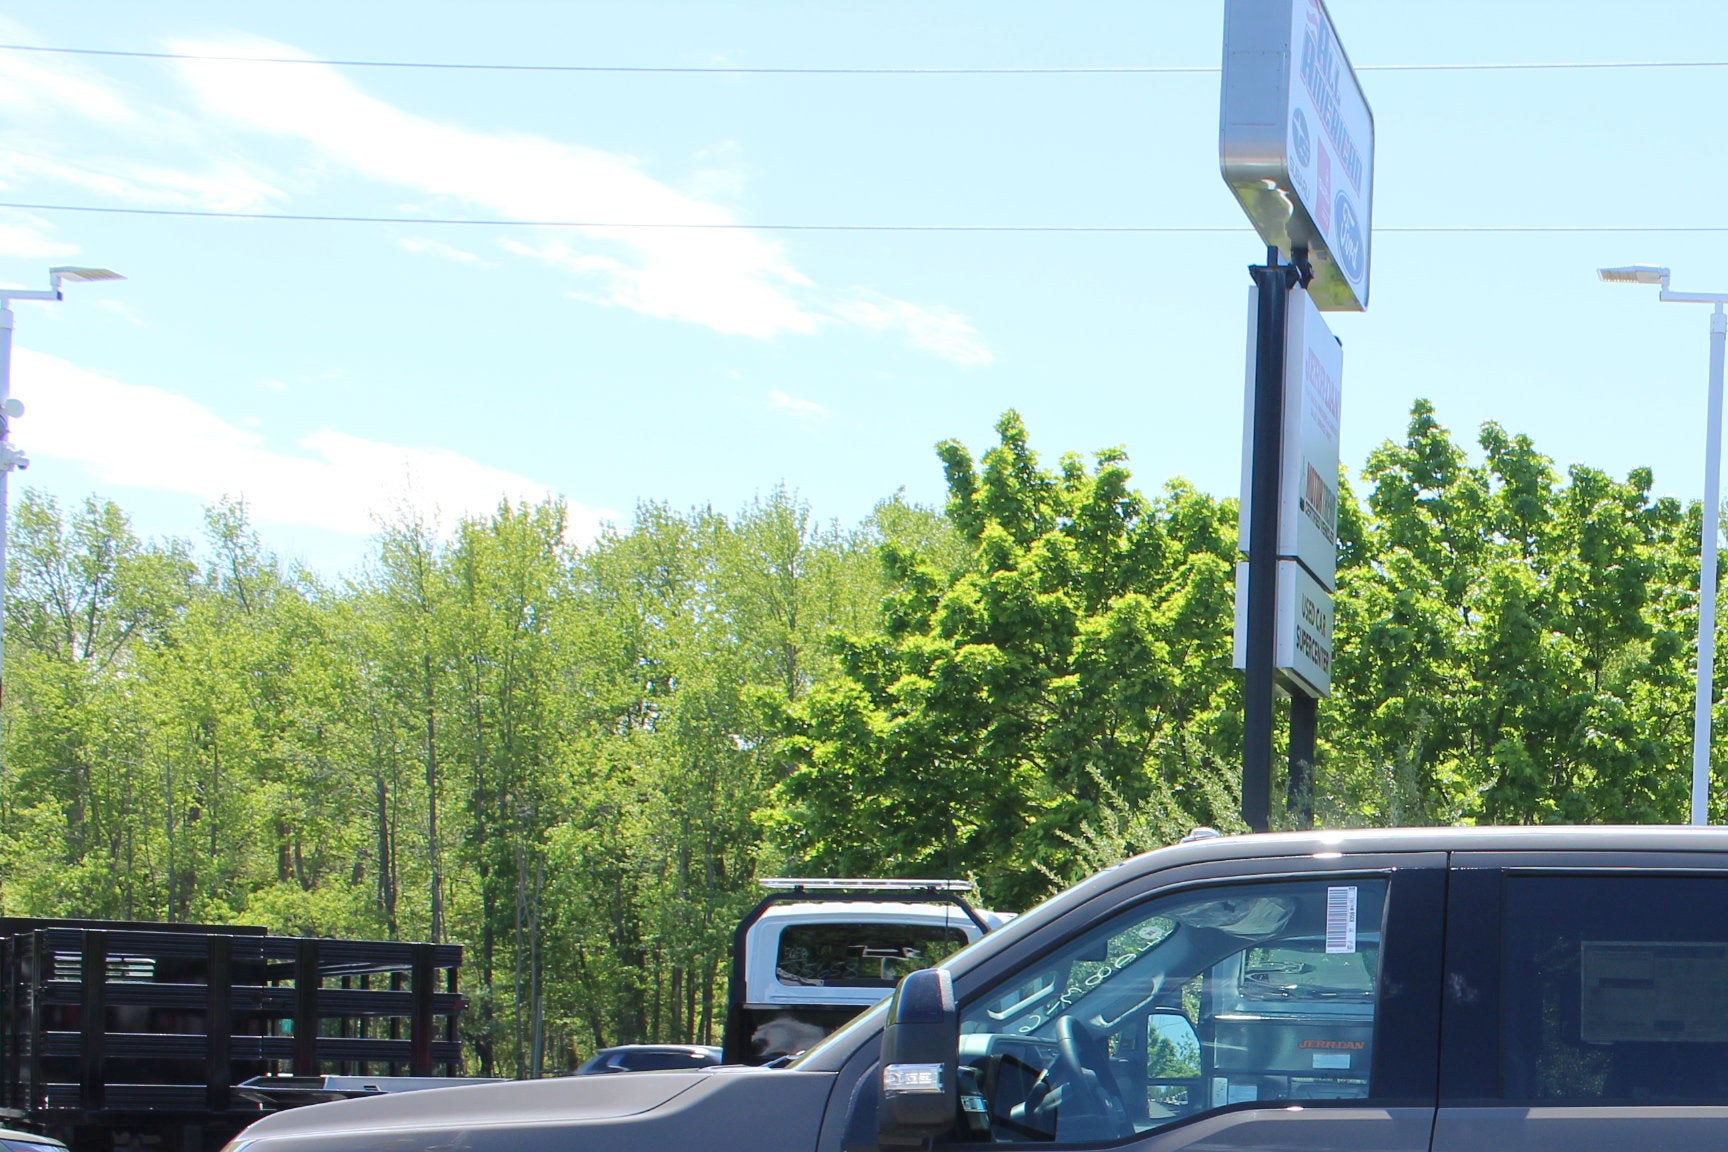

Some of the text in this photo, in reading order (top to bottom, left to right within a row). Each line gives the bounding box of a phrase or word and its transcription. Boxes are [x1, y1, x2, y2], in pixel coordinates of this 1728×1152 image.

[1301, 593, 1326, 637] USED CAR
[1296, 624, 1330, 674] SUPERCENTER
